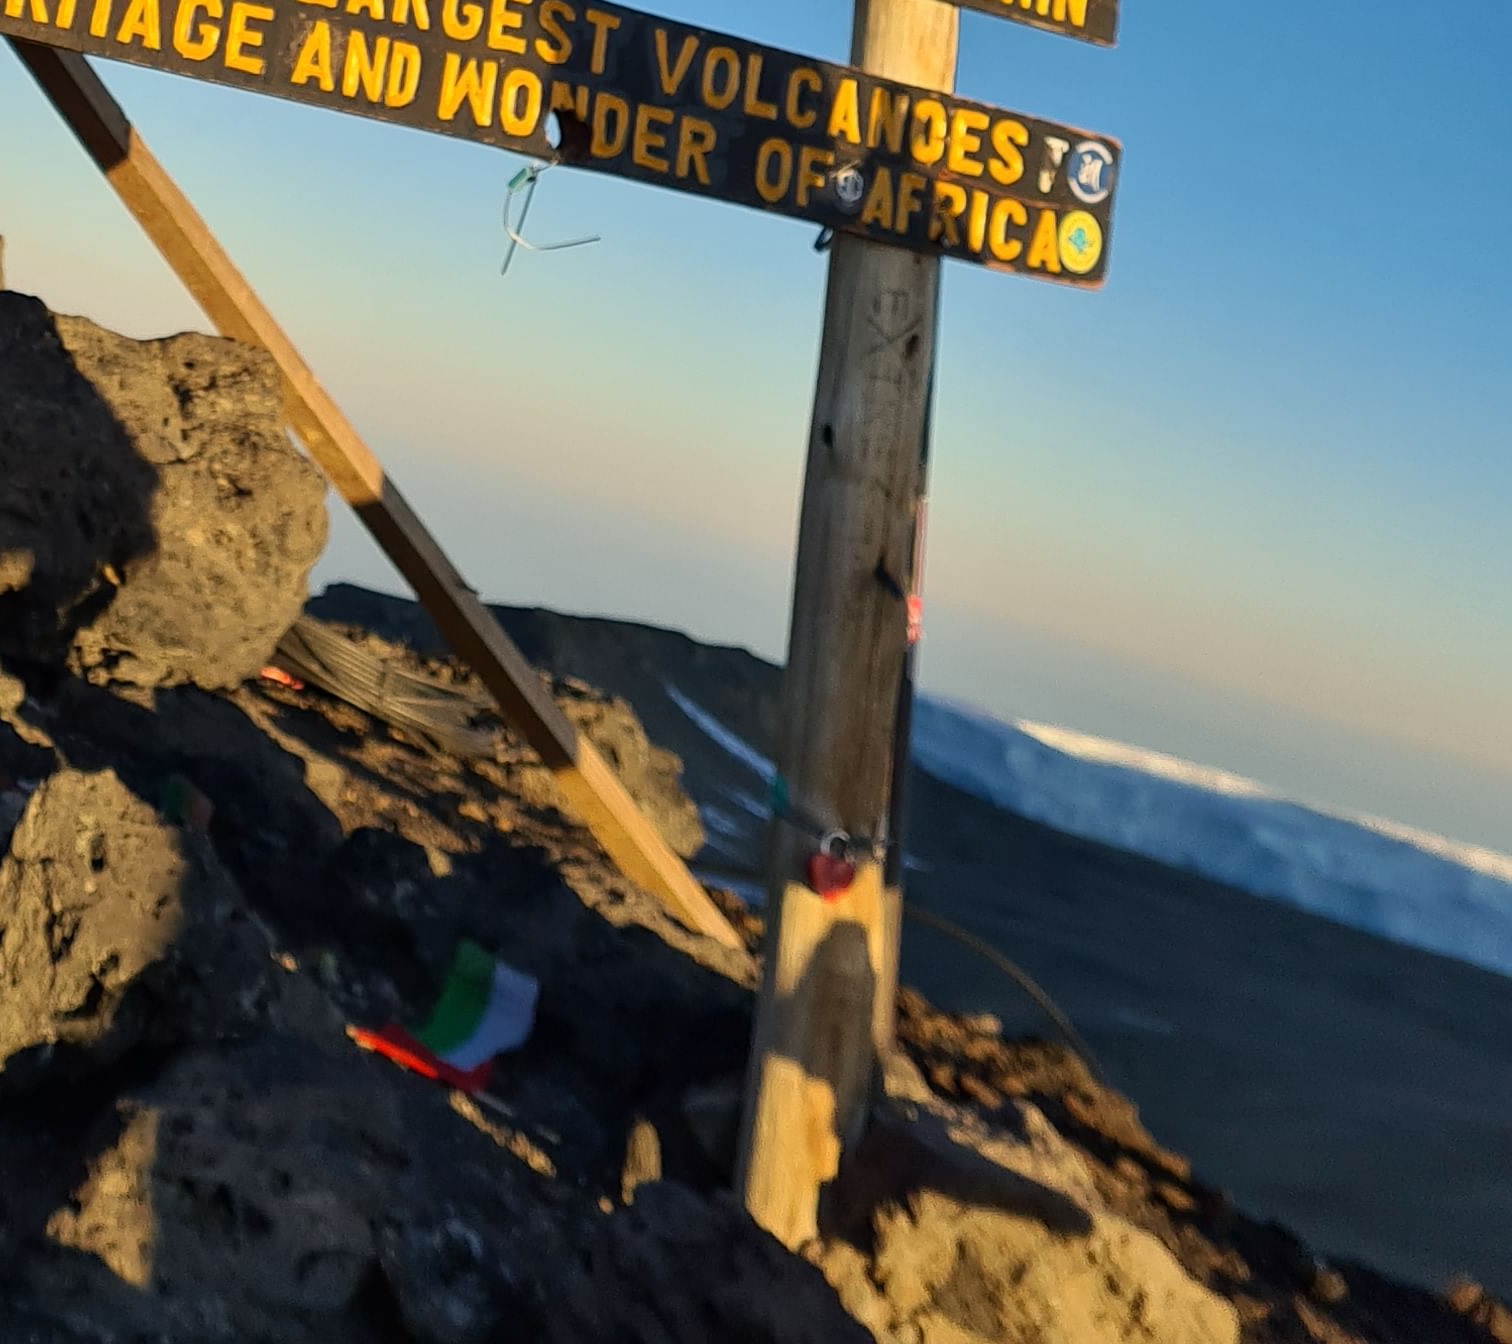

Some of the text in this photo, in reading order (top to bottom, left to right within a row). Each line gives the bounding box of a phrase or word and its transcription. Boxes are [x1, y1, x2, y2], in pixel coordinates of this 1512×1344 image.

[289, 18, 421, 110] AND
[753, 134, 837, 206] OF
[861, 166, 1062, 273] AFRICA
[653, 28, 1029, 187] VOLCANOES
